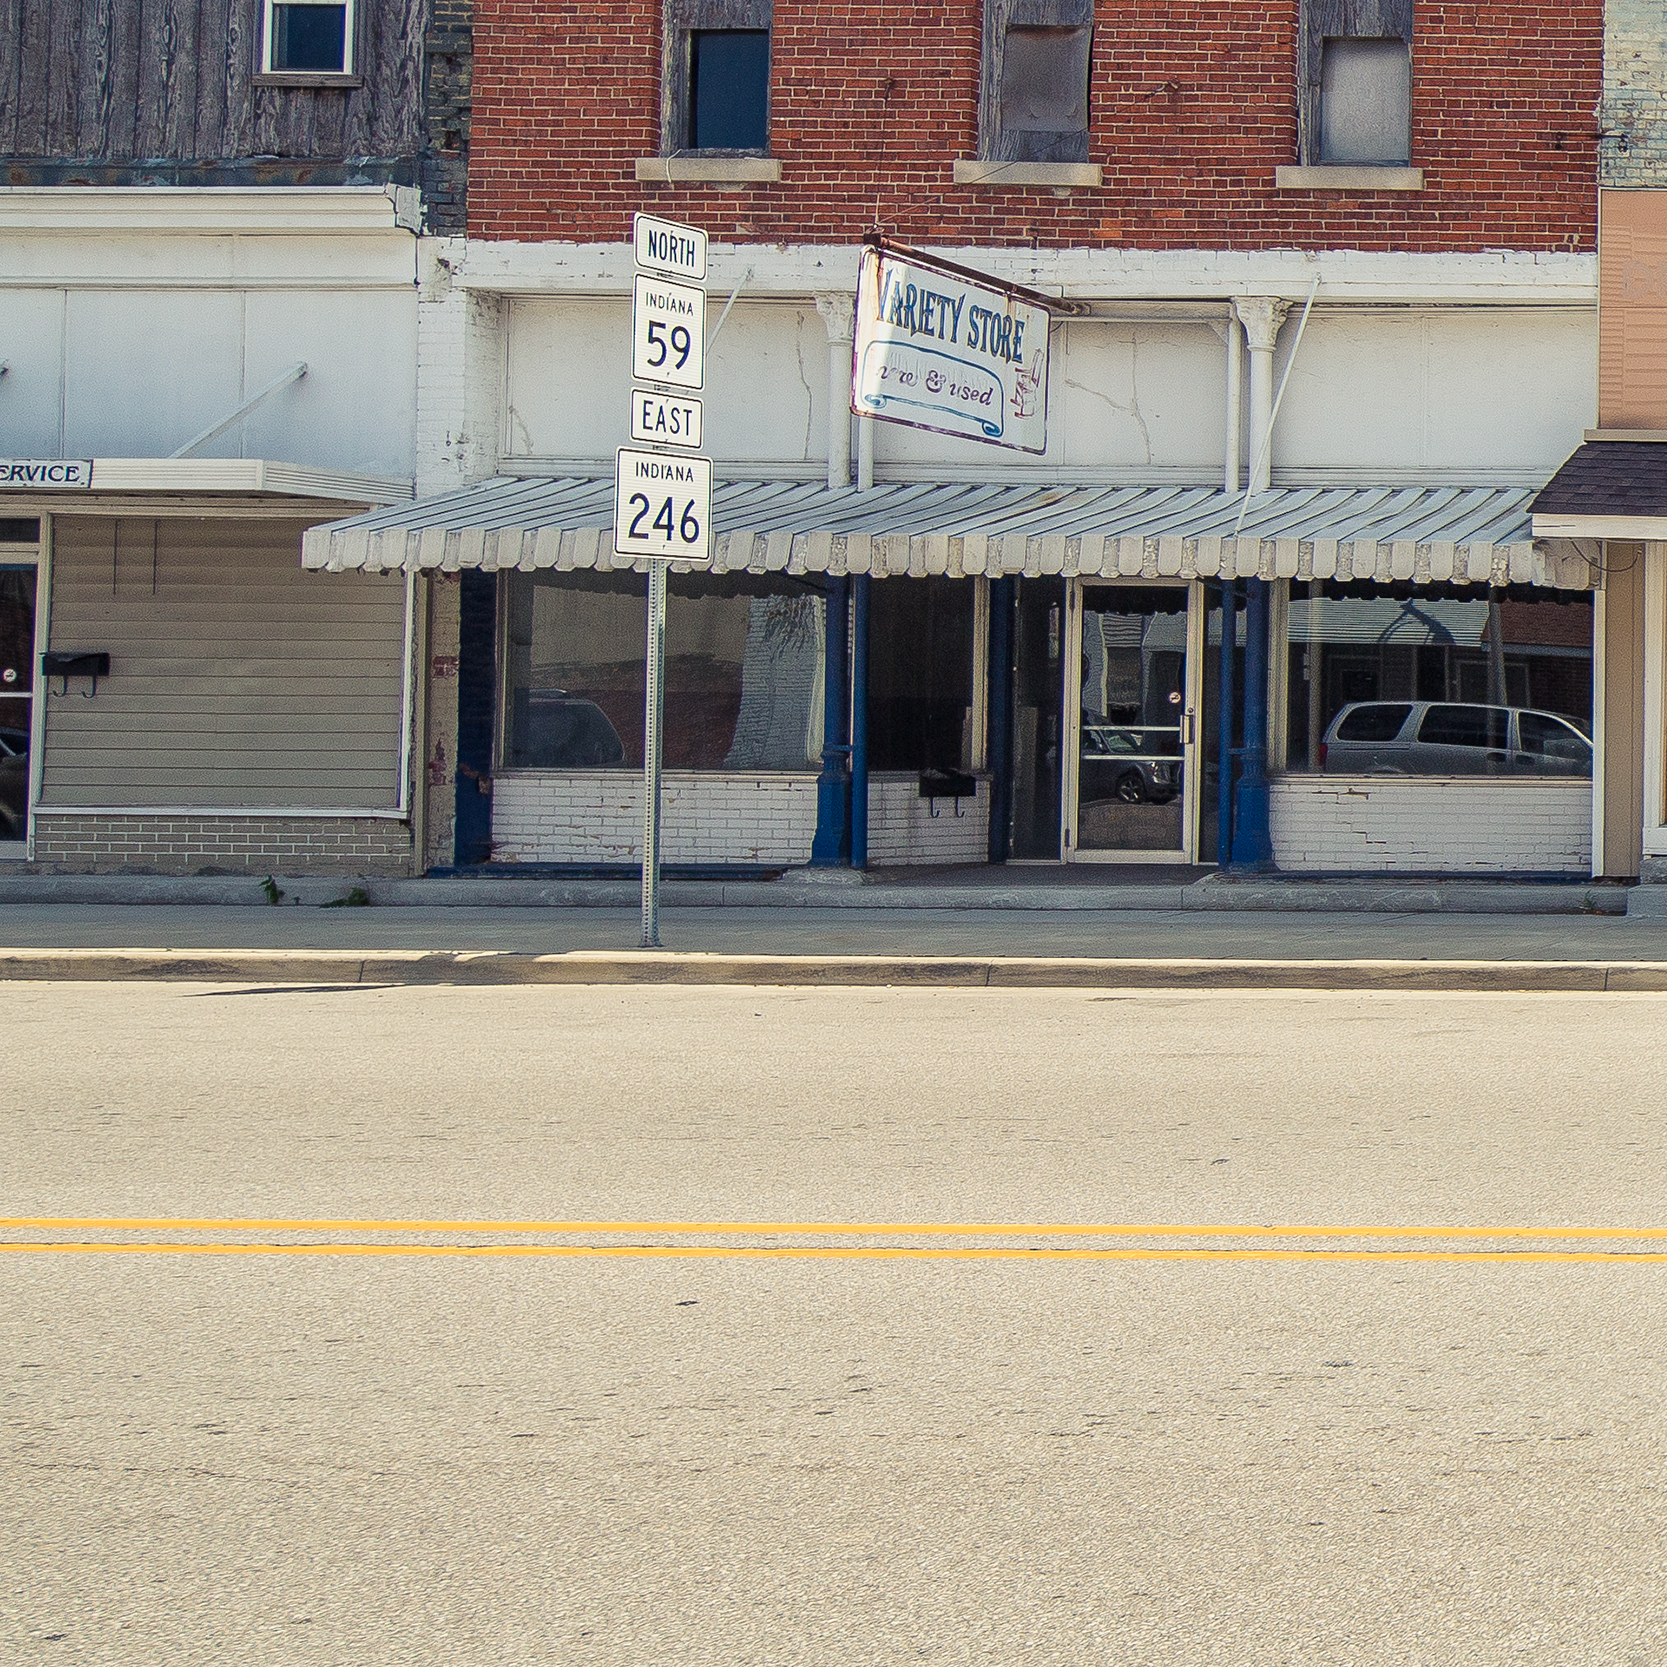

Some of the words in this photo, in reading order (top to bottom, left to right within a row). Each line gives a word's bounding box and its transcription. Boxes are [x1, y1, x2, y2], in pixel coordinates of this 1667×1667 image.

[648, 230, 695, 268] NORTH
[645, 292, 694, 316] INDIANA
[877, 268, 966, 344] VARIETY
[966, 304, 1026, 365] STORE
[647, 319, 691, 370] 59
[925, 370, 947, 393] &
[949, 383, 994, 406] used
[643, 400, 692, 436] EAST
[635, 461, 694, 482] INDIANA
[628, 492, 700, 544] 246
